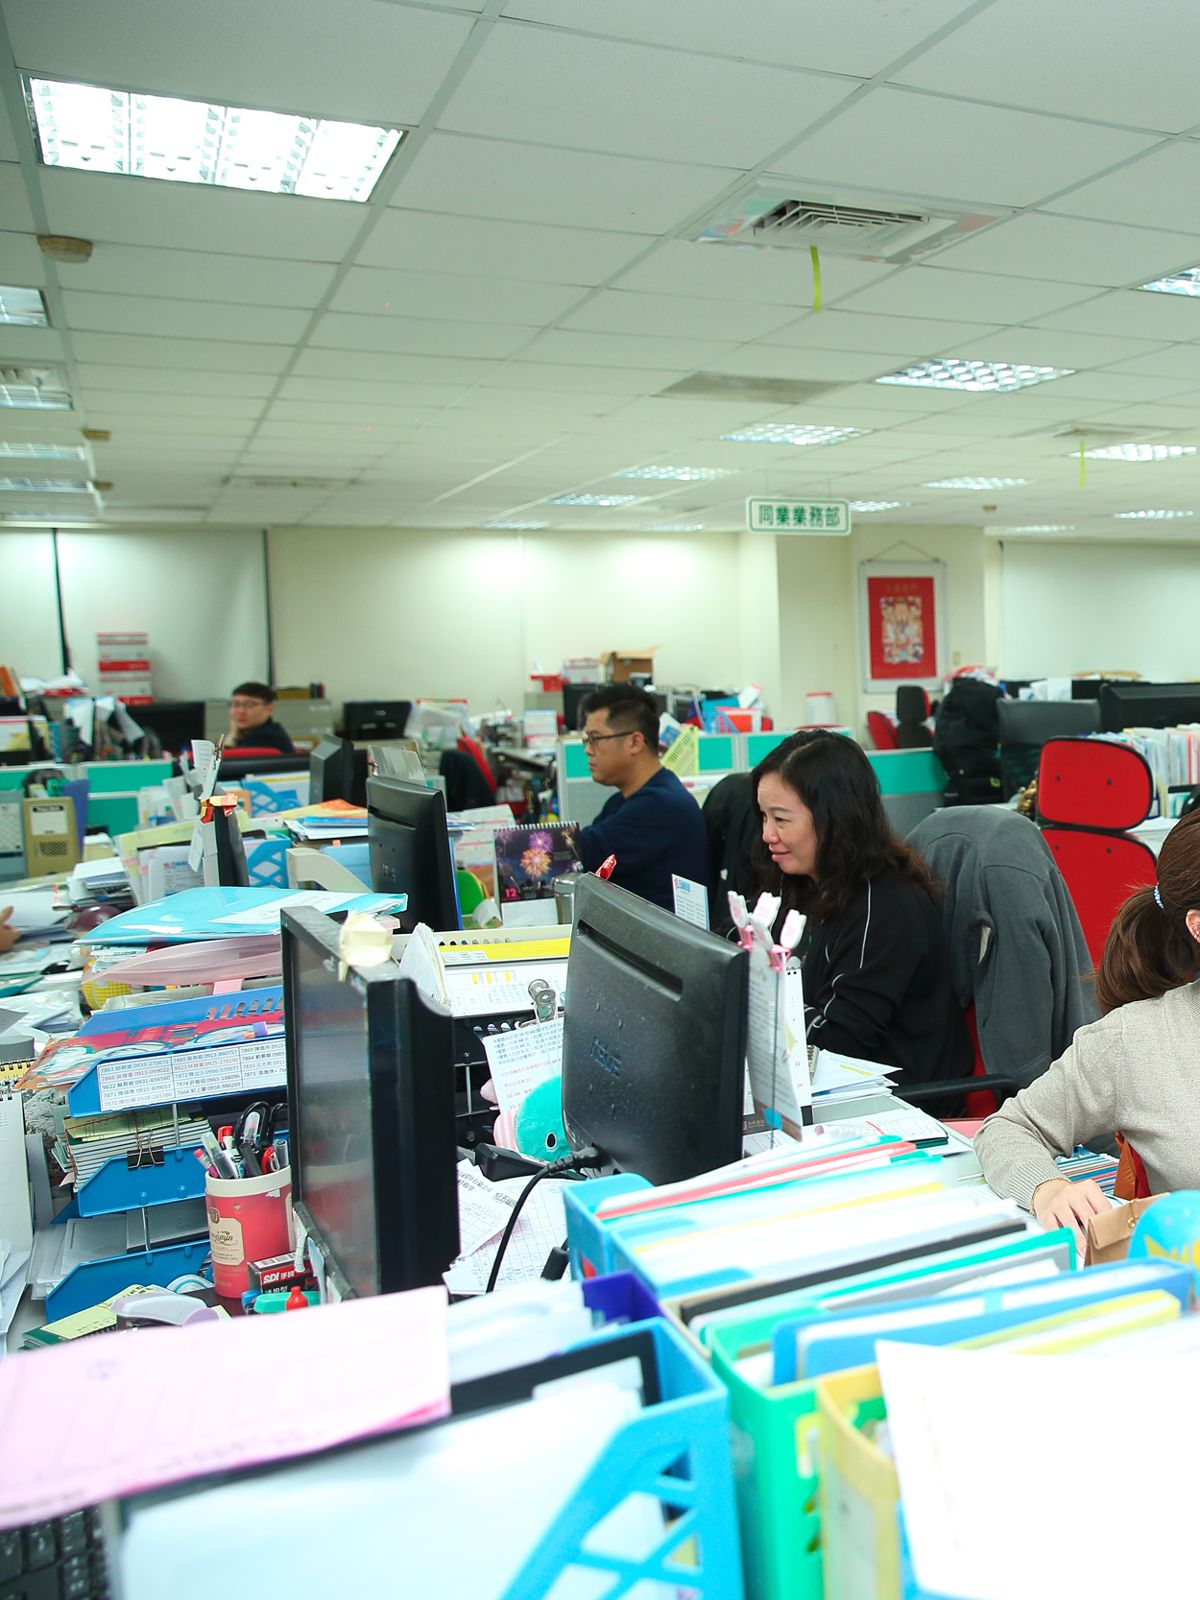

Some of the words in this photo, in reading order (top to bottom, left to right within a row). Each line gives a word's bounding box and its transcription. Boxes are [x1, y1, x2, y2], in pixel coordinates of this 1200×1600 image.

[758, 504, 841, 528] 同業業務部
[505, 888, 517, 897] 12
[263, 1272, 280, 1284] SDI
